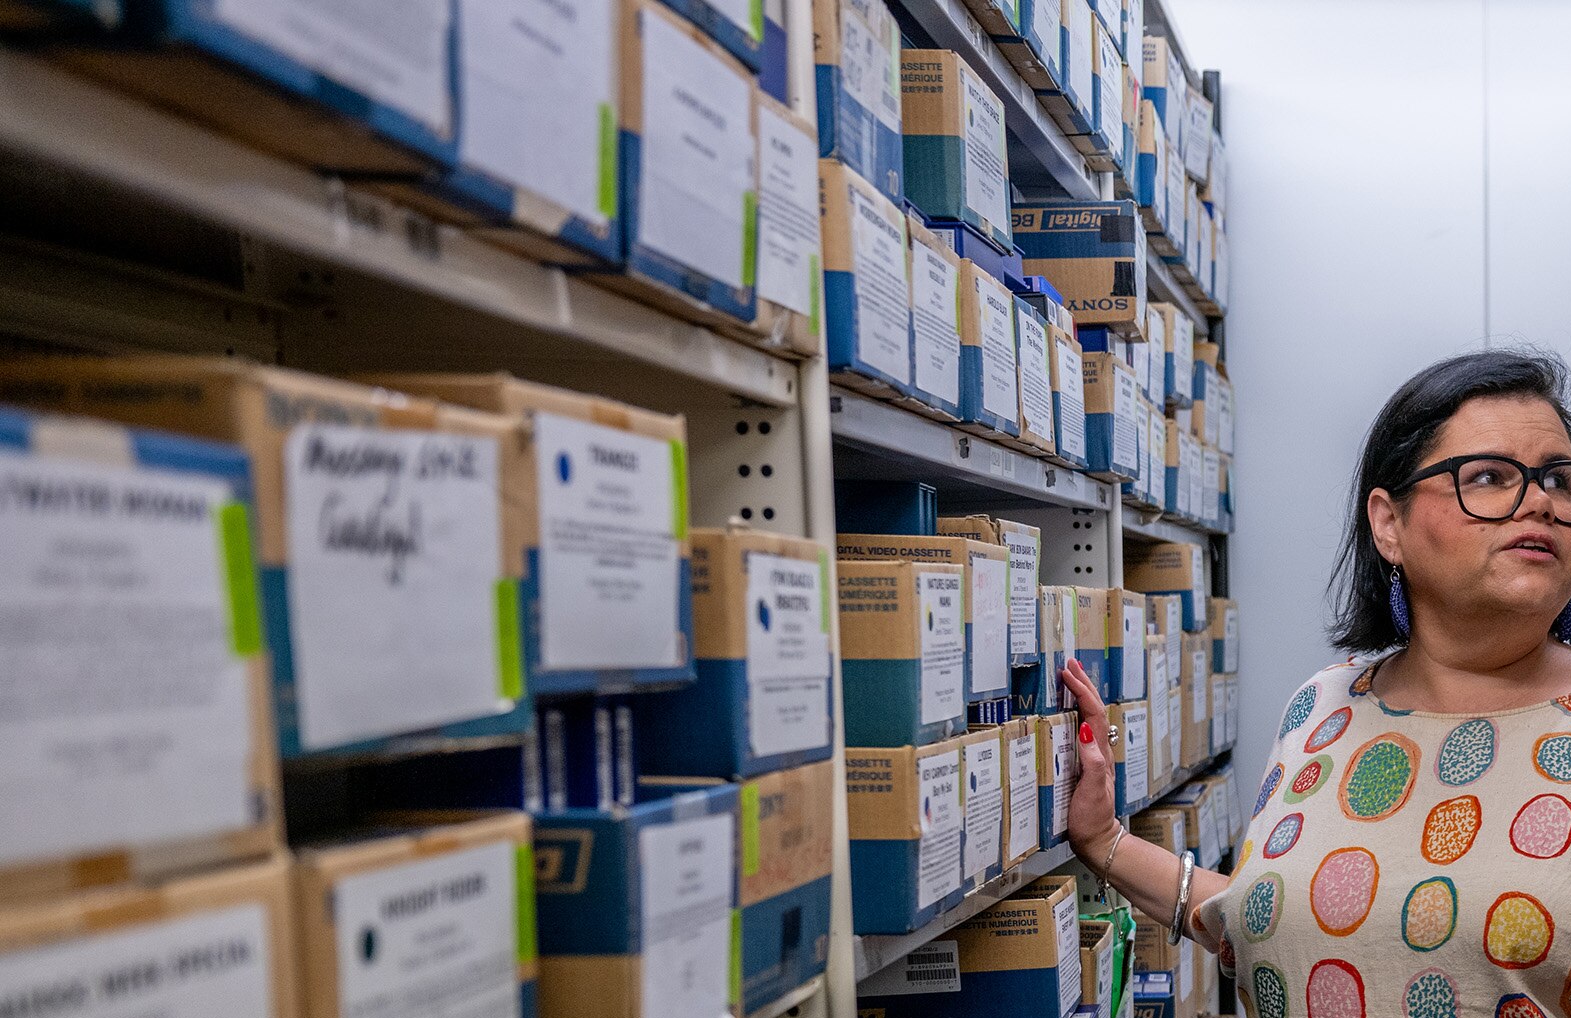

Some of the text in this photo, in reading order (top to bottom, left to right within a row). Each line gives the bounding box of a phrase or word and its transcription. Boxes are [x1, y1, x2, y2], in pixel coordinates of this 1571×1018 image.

[901, 62, 942, 71] ASSETTE
[901, 73, 943, 82] MÉRIQUE
[1012, 211, 1102, 228] igital Be
[1068, 298, 1128, 311] SONY
[935, 532, 981, 541] CASSETTE
[837, 546, 952, 558] GITAL VIDEO CASSETTE
[839, 577, 897, 587] CASSETTE
[838, 588, 897, 600] UMÉRIQUE
[1078, 595, 1091, 608] SONY
[846, 758, 892, 768] ASSETTE
[846, 769, 892, 781] MÉRIQUE
[994, 909, 1037, 918] CASSETTE
[988, 918, 1038, 929] NUMÉRIQUE
